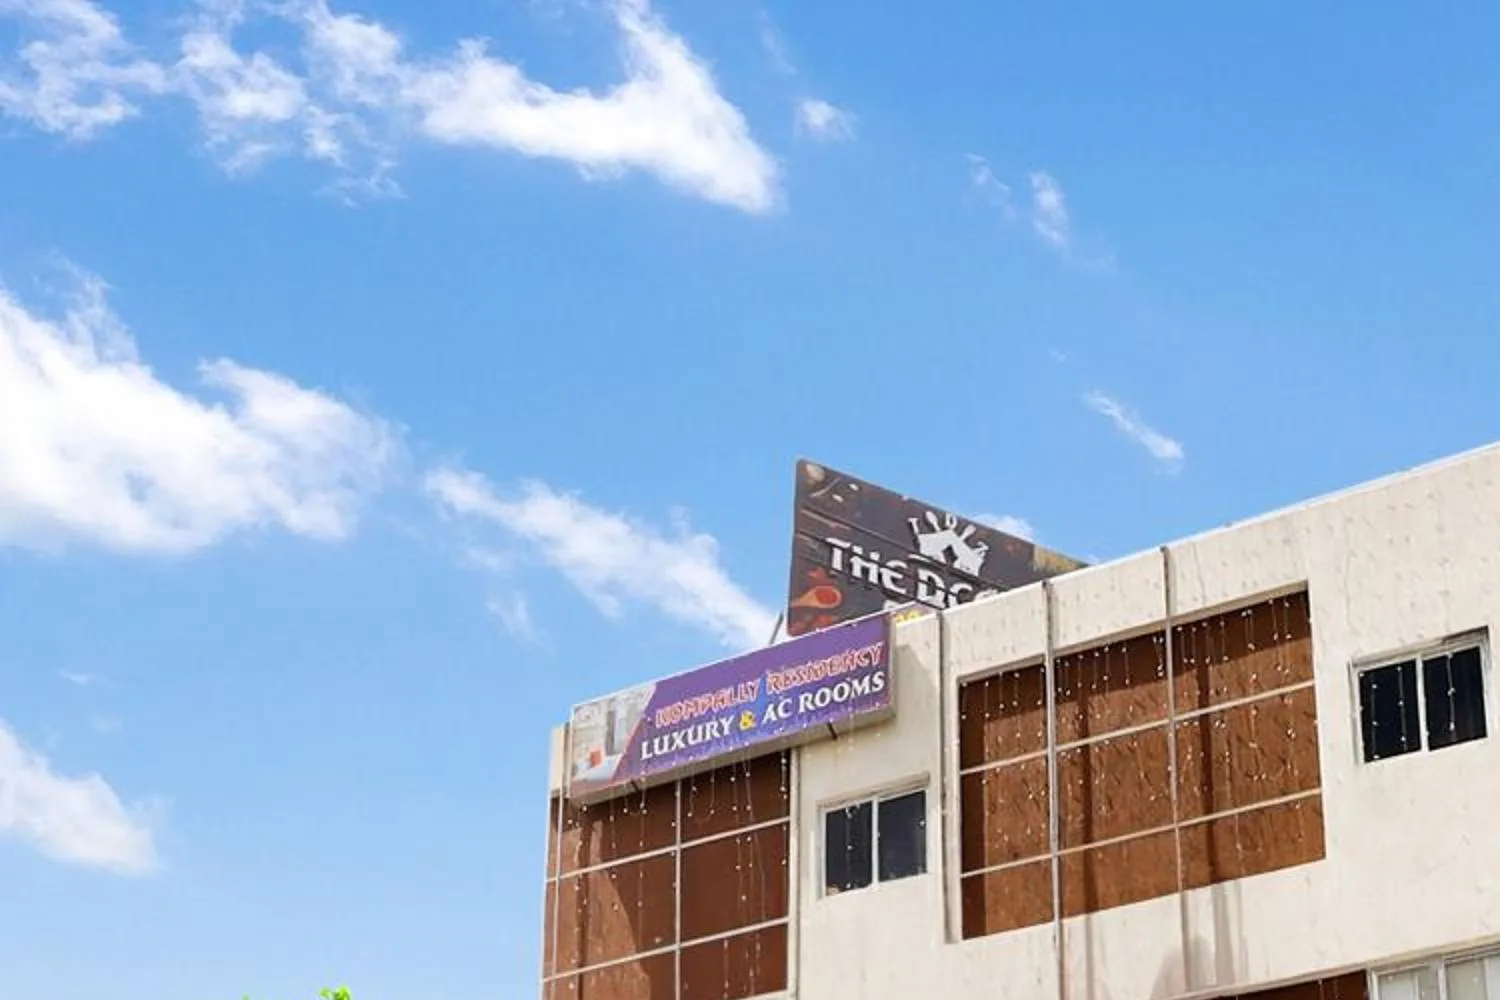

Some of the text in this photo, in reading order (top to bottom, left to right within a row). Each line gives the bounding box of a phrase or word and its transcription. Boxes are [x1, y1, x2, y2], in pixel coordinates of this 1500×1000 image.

[825, 537, 909, 595] THE
[640, 672, 885, 760] LUXURY & AC ROOMS
